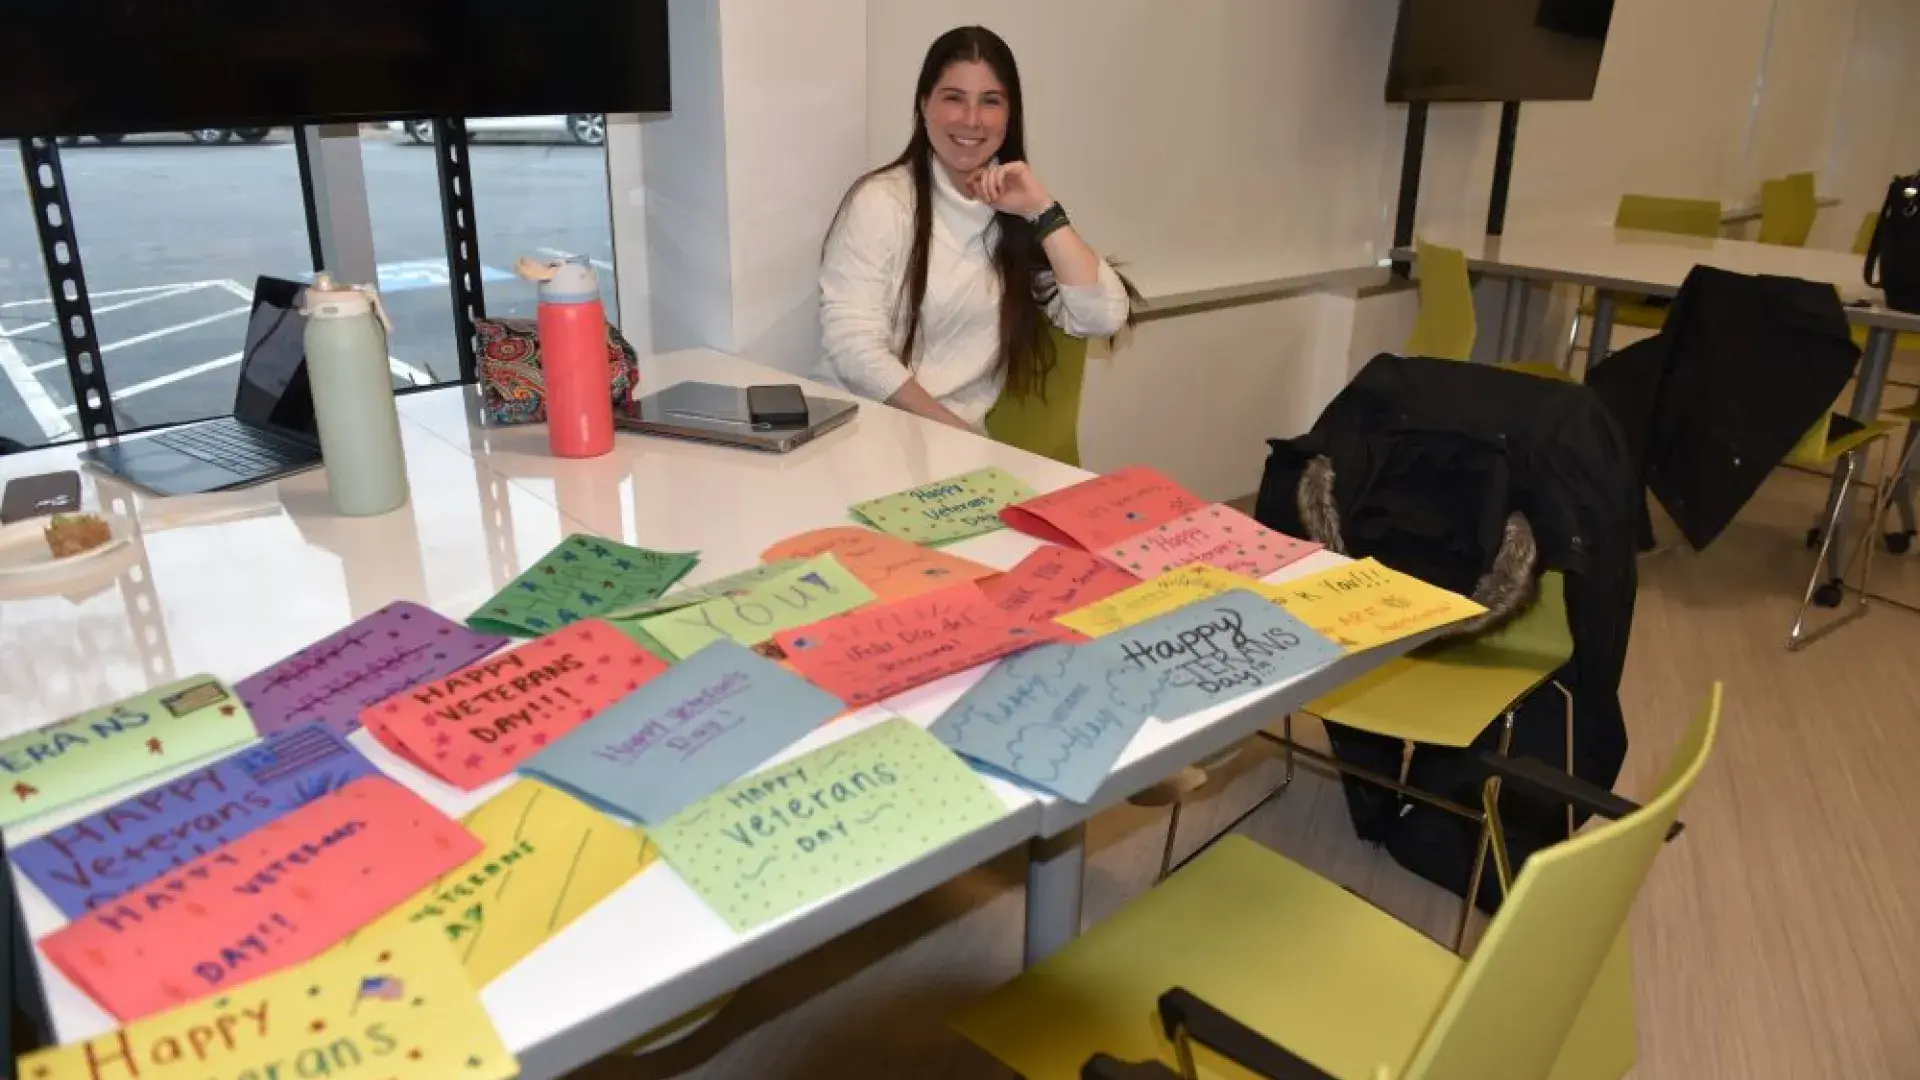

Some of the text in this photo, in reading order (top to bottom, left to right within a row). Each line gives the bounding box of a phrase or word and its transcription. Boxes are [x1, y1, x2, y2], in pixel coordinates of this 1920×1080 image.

[1120, 608, 1245, 673] Happy
[1170, 627, 1301, 688] TERANS
[412, 653, 525, 705] HAPPY
[434, 652, 585, 722] VETERANS
[44, 768, 228, 859] HAPPY
[720, 762, 898, 848] Veterans
[726, 766, 809, 811] HAPPY
[48, 789, 272, 889] Veterans
[82, 999, 271, 1080] Happy
